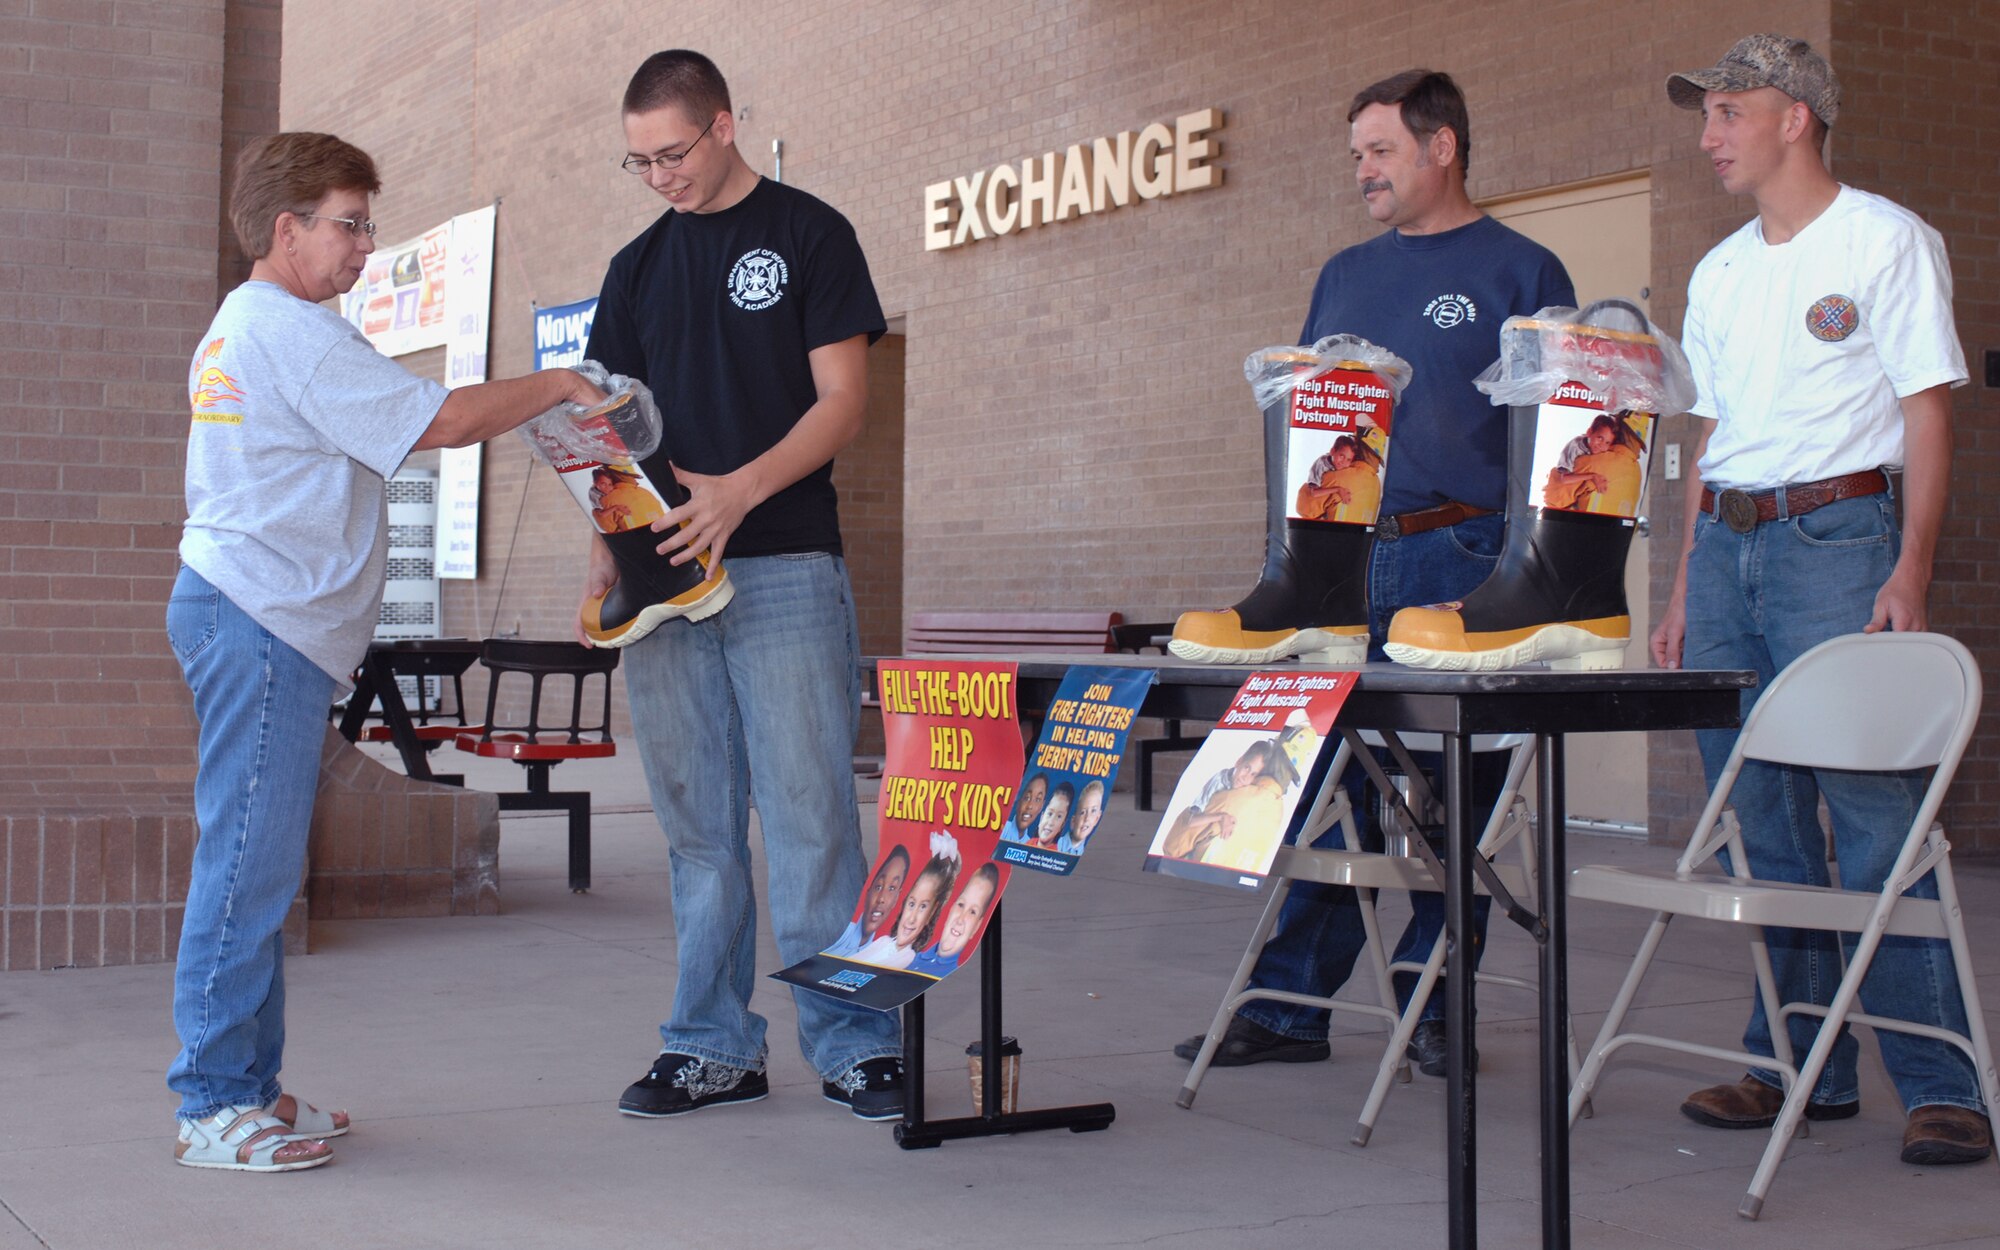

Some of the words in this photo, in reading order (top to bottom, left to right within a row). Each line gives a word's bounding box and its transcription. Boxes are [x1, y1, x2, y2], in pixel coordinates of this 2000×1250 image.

[925, 108, 1215, 251] EXCHANGE
[727, 248, 761, 289] DEPARTMENT
[761, 249, 773, 257] OF
[771, 252, 788, 285] DEFENSE
[729, 292, 745, 308] FIRE
[744, 289, 784, 311] ACADEMY
[1438, 294, 1454, 302] FILL
[1456, 294, 1471, 305] THE
[1466, 303, 1476, 322] BOOT
[537, 311, 587, 350] Now
[1297, 379, 1321, 394] Help
[1324, 380, 1345, 394] Fire
[1348, 383, 1390, 399] Fighters
[1296, 394, 1325, 409] Fight
[1327, 396, 1376, 413] Muscular
[1295, 409, 1349, 427] Dystrophy
[882, 670, 1011, 719] FILL-THE-BOOT
[1083, 684, 1113, 701] JOIN
[1246, 677, 1273, 693] Help
[1271, 677, 1293, 691] Fire
[1291, 676, 1337, 692] Fighters
[1236, 693, 1266, 709] Fight
[1262, 693, 1312, 708] Muscular
[1049, 699, 1079, 723] FIRE
[1074, 702, 1135, 730] FIGHTERS
[1224, 709, 1275, 726] Dystrophy
[929, 726, 974, 771] HELP
[1051, 725, 1066, 742] IN
[1065, 727, 1115, 749] HELPING
[1037, 743, 1084, 773] "JERRY'S
[1082, 751, 1120, 777] KIDS"
[885, 776, 957, 825] 'JERRY'S
[958, 783, 1012, 831] KIDS'
[1004, 847, 1028, 863] MDA
